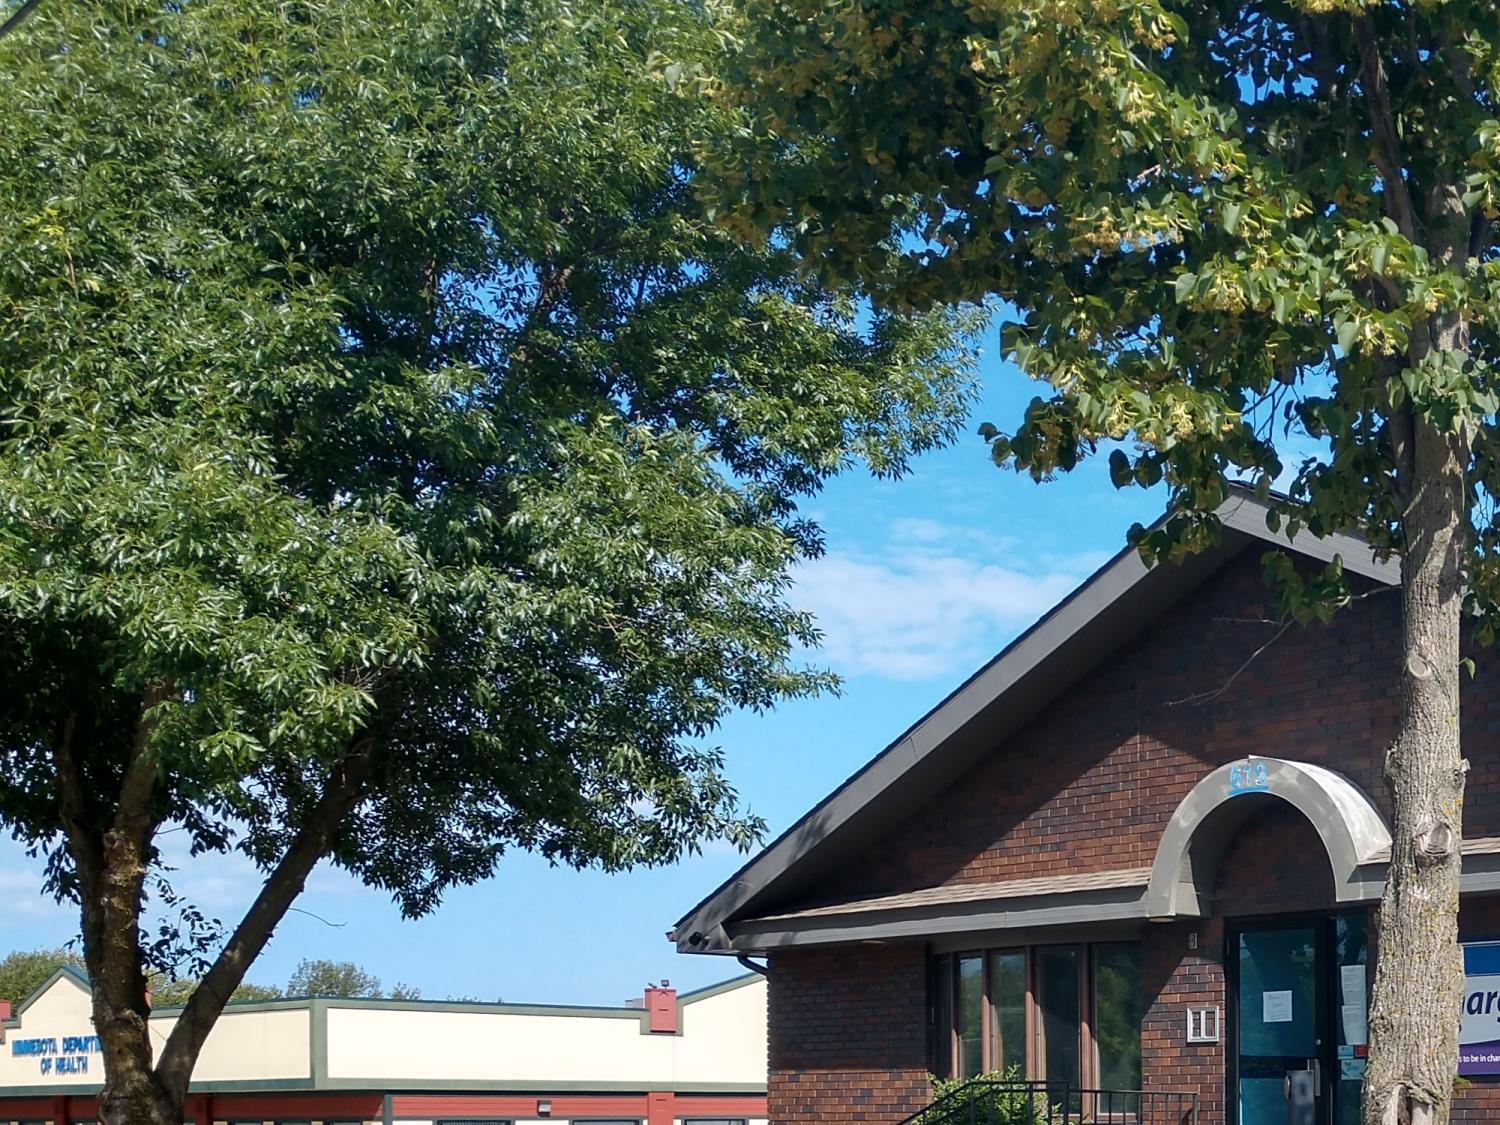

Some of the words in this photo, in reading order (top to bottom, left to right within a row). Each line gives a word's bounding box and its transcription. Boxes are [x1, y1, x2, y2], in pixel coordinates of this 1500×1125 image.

[12, 1038, 57, 1056] MINNESOTA
[40, 1056, 52, 1075] OF
[55, 1056, 88, 1074] HEALTH
[1463, 1055, 1470, 1063] to
[1471, 1054, 1479, 1063] be
[1480, 1054, 1487, 1062] in
